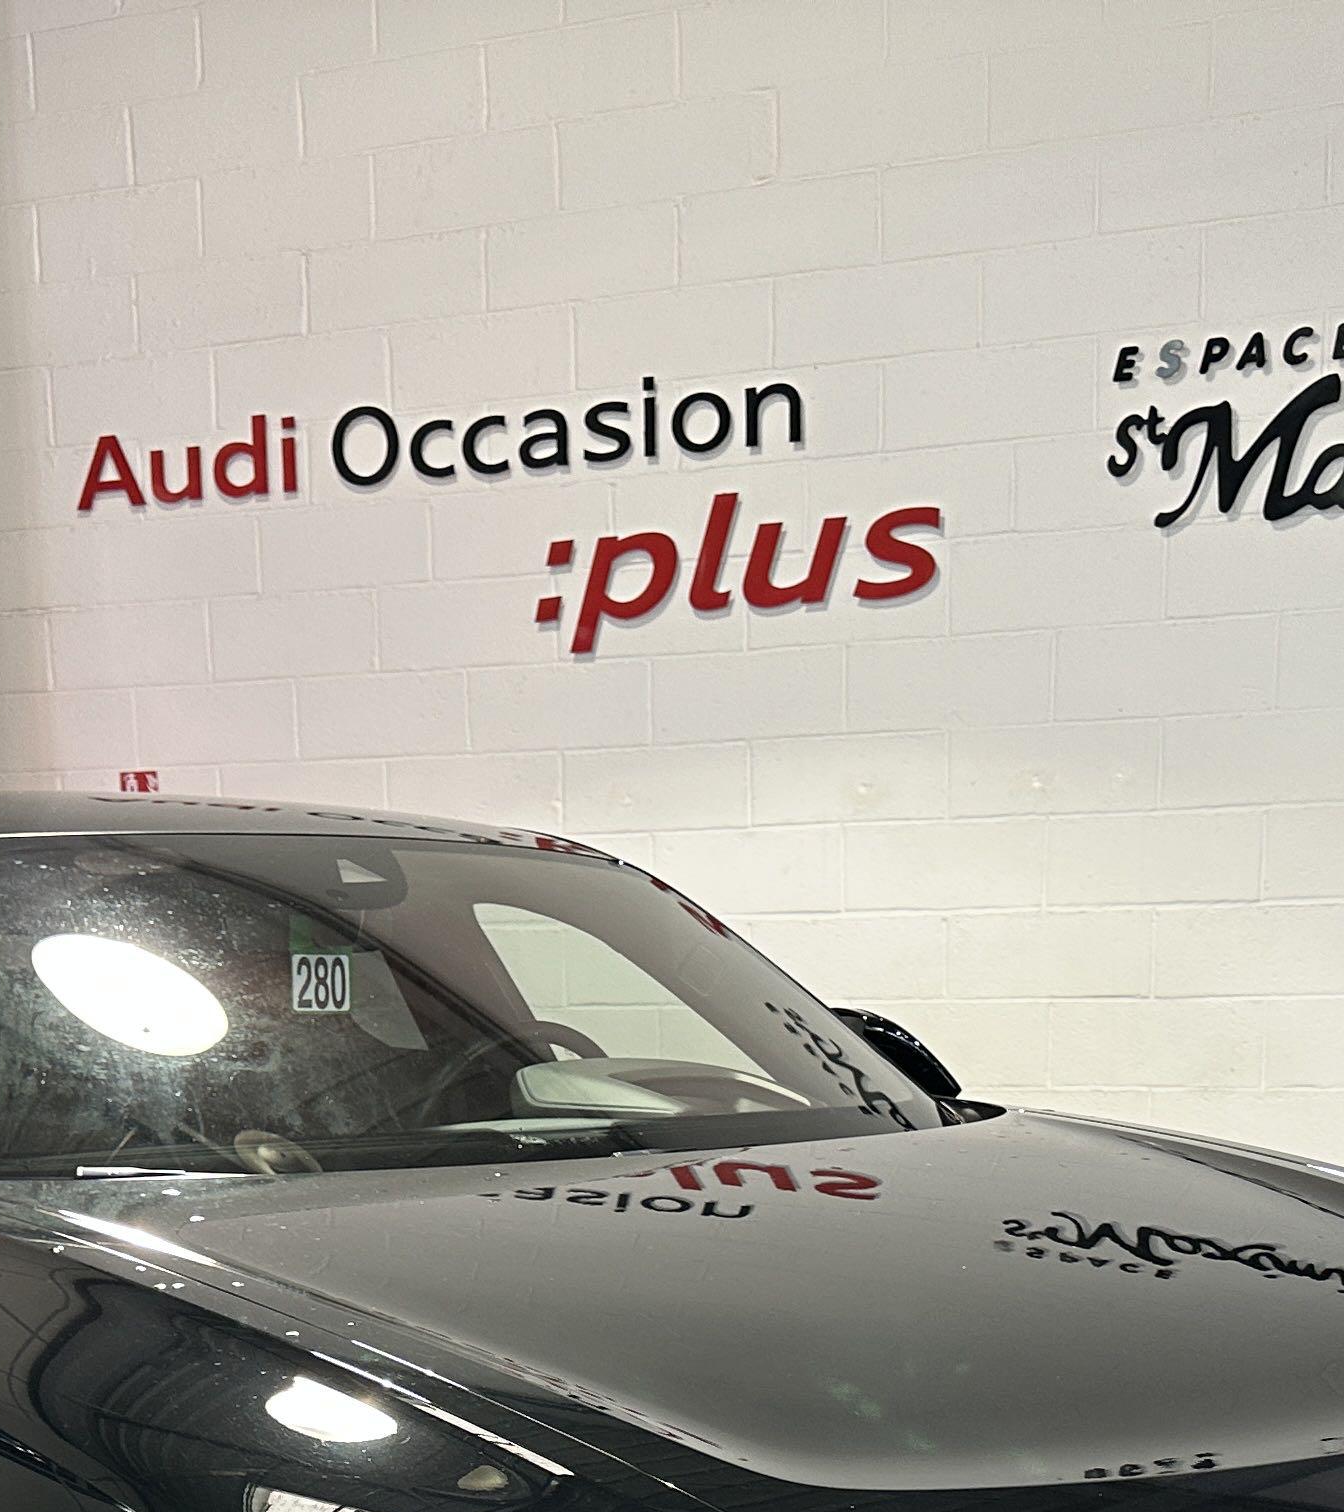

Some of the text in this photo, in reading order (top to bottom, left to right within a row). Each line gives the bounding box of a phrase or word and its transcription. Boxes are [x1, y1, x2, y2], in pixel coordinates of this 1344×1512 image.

[77, 376, 804, 512] Audi Occasion
[296, 956, 347, 1010] 280
